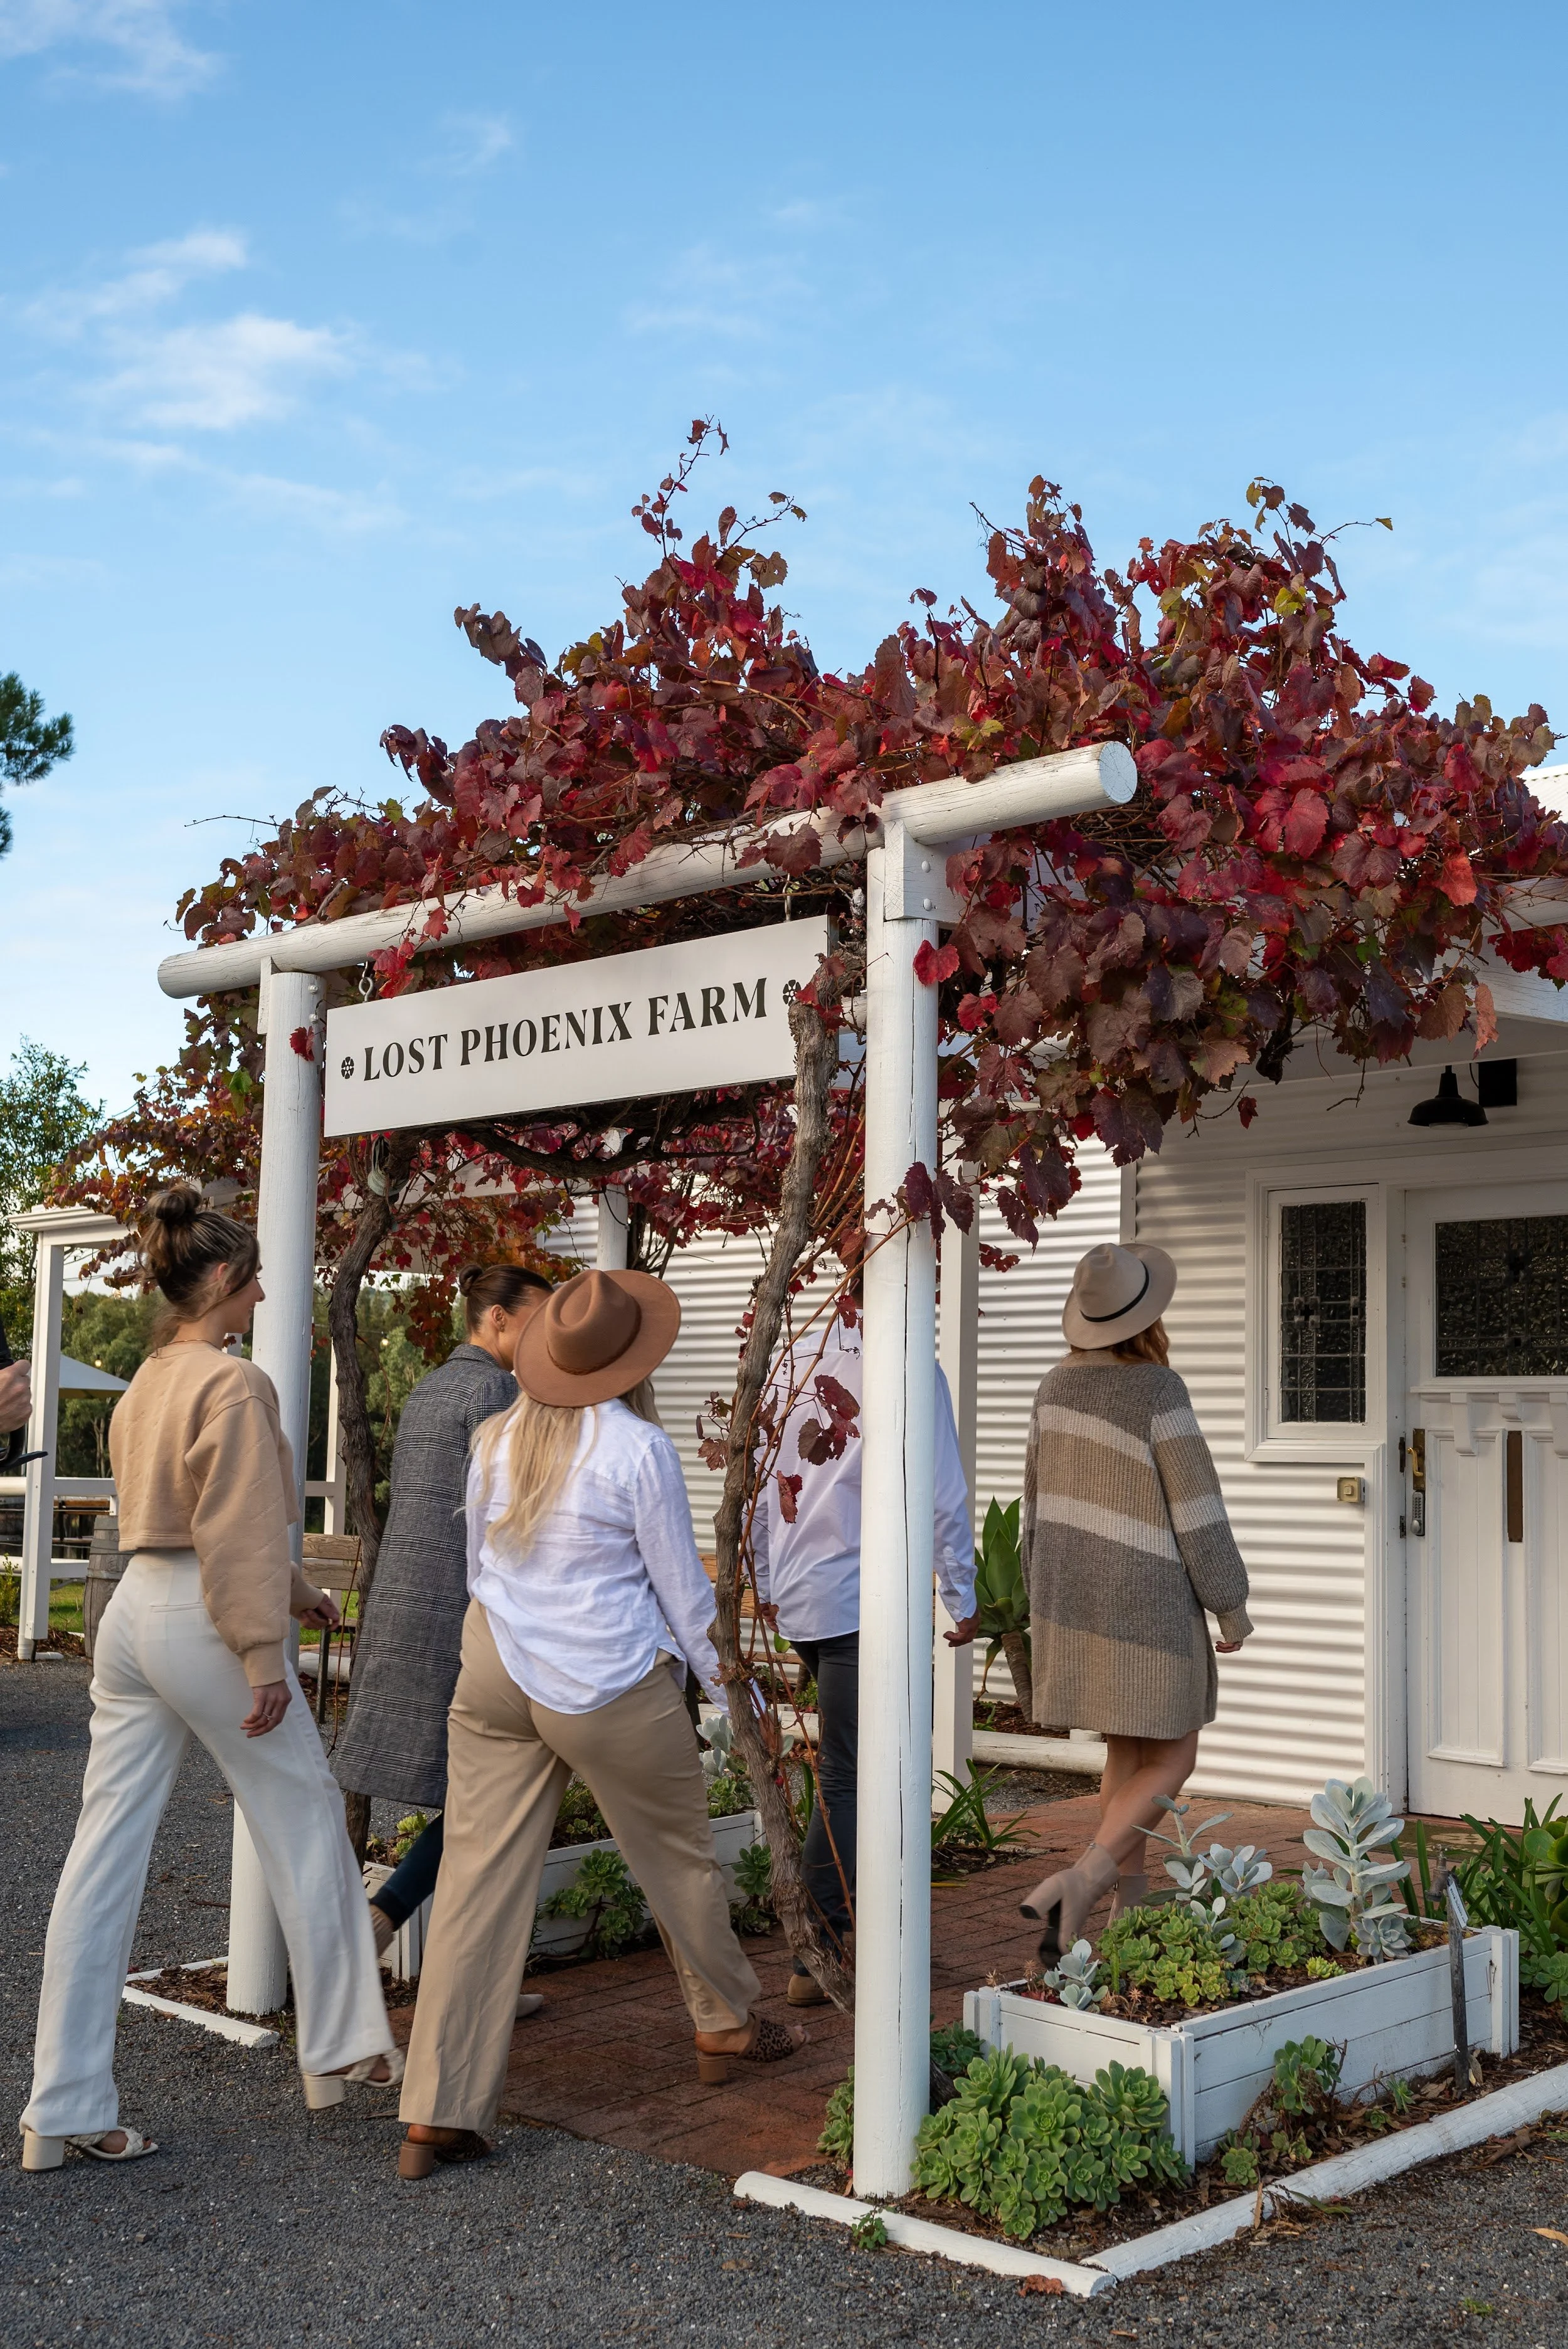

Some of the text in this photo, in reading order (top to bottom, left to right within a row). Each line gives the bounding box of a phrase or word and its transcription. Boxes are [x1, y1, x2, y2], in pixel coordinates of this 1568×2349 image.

[364, 978, 767, 1081] LOST PHOENIX FARM
